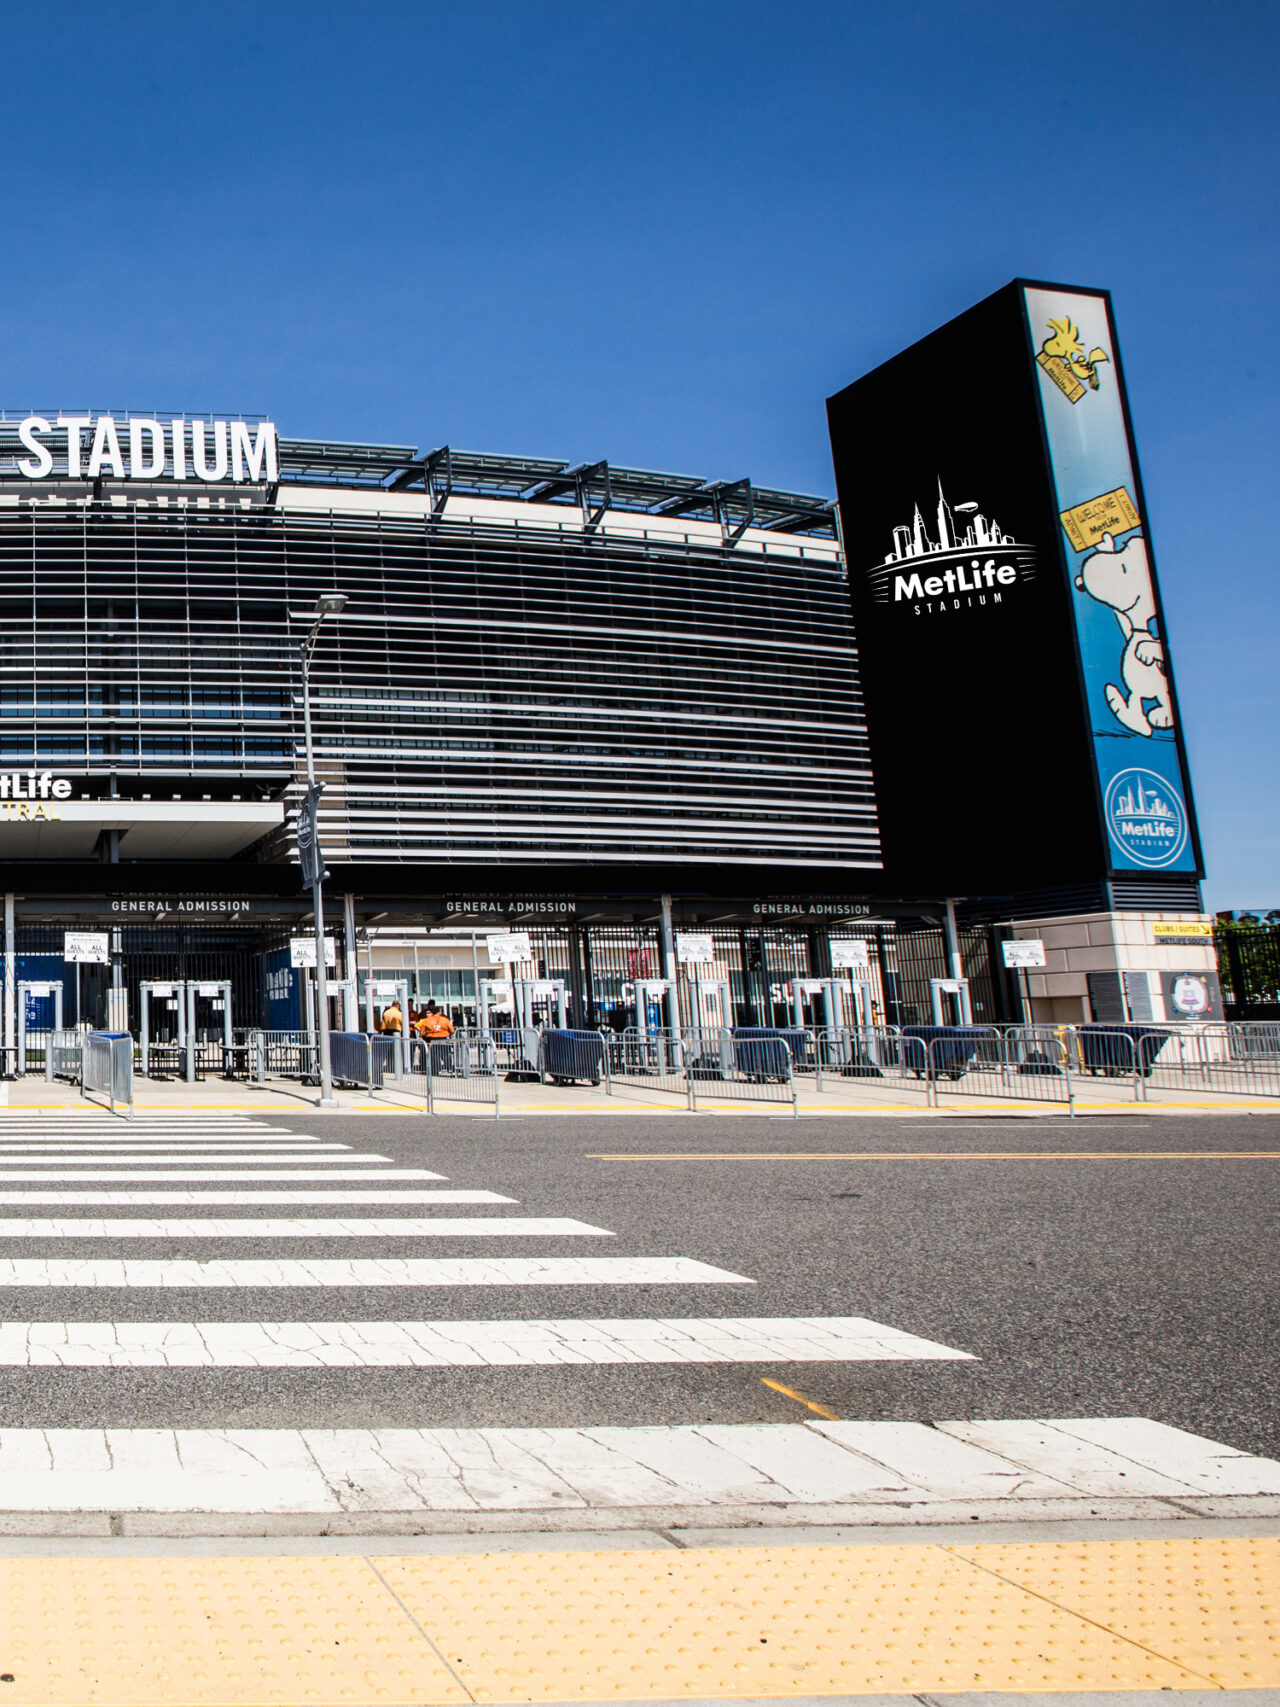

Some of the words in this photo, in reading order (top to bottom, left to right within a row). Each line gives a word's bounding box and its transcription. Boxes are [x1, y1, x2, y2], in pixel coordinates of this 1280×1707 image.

[16, 416, 279, 483] STADIUM
[1076, 497, 1117, 524] WELCOME
[1089, 516, 1120, 536] MetLife
[894, 559, 1017, 602] MetLife
[914, 592, 1002, 615] STADIUM
[1121, 821, 1175, 837] MetLife
[111, 901, 172, 911] GENERAL
[177, 901, 250, 911] ADMISSION
[446, 902, 504, 912] GENERAL
[508, 902, 576, 912] ADMISSION
[753, 904, 805, 914] GENERAL
[809, 905, 870, 914] ADMISSION
